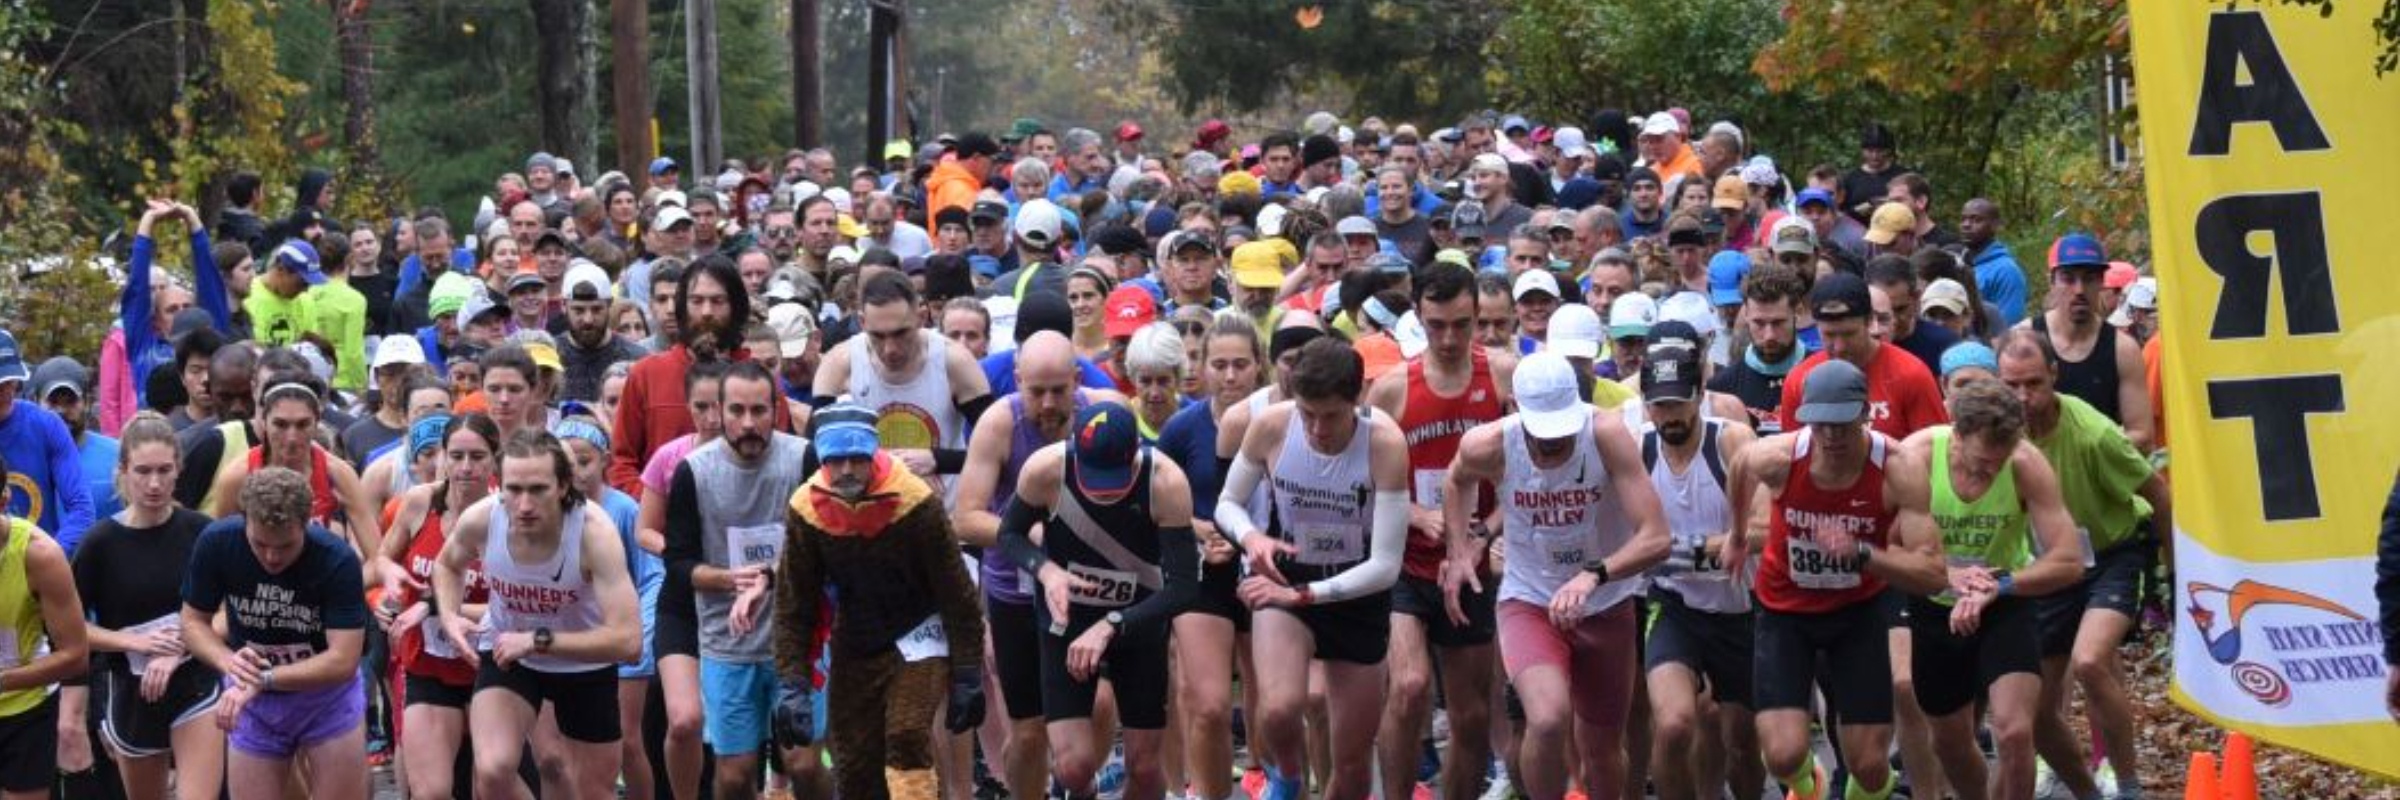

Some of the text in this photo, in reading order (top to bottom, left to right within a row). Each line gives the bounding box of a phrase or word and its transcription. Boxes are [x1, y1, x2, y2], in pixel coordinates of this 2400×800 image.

[1407, 418, 1483, 446] WHIRLAW
[1275, 476, 1355, 502] Millennium
[1514, 485, 1601, 509] RUNNER'S
[1532, 508, 1584, 527] ALLEY
[1785, 507, 1876, 534] RUNNER'S
[256, 583, 295, 603] NEW
[491, 577, 578, 604] RUNNER'S
